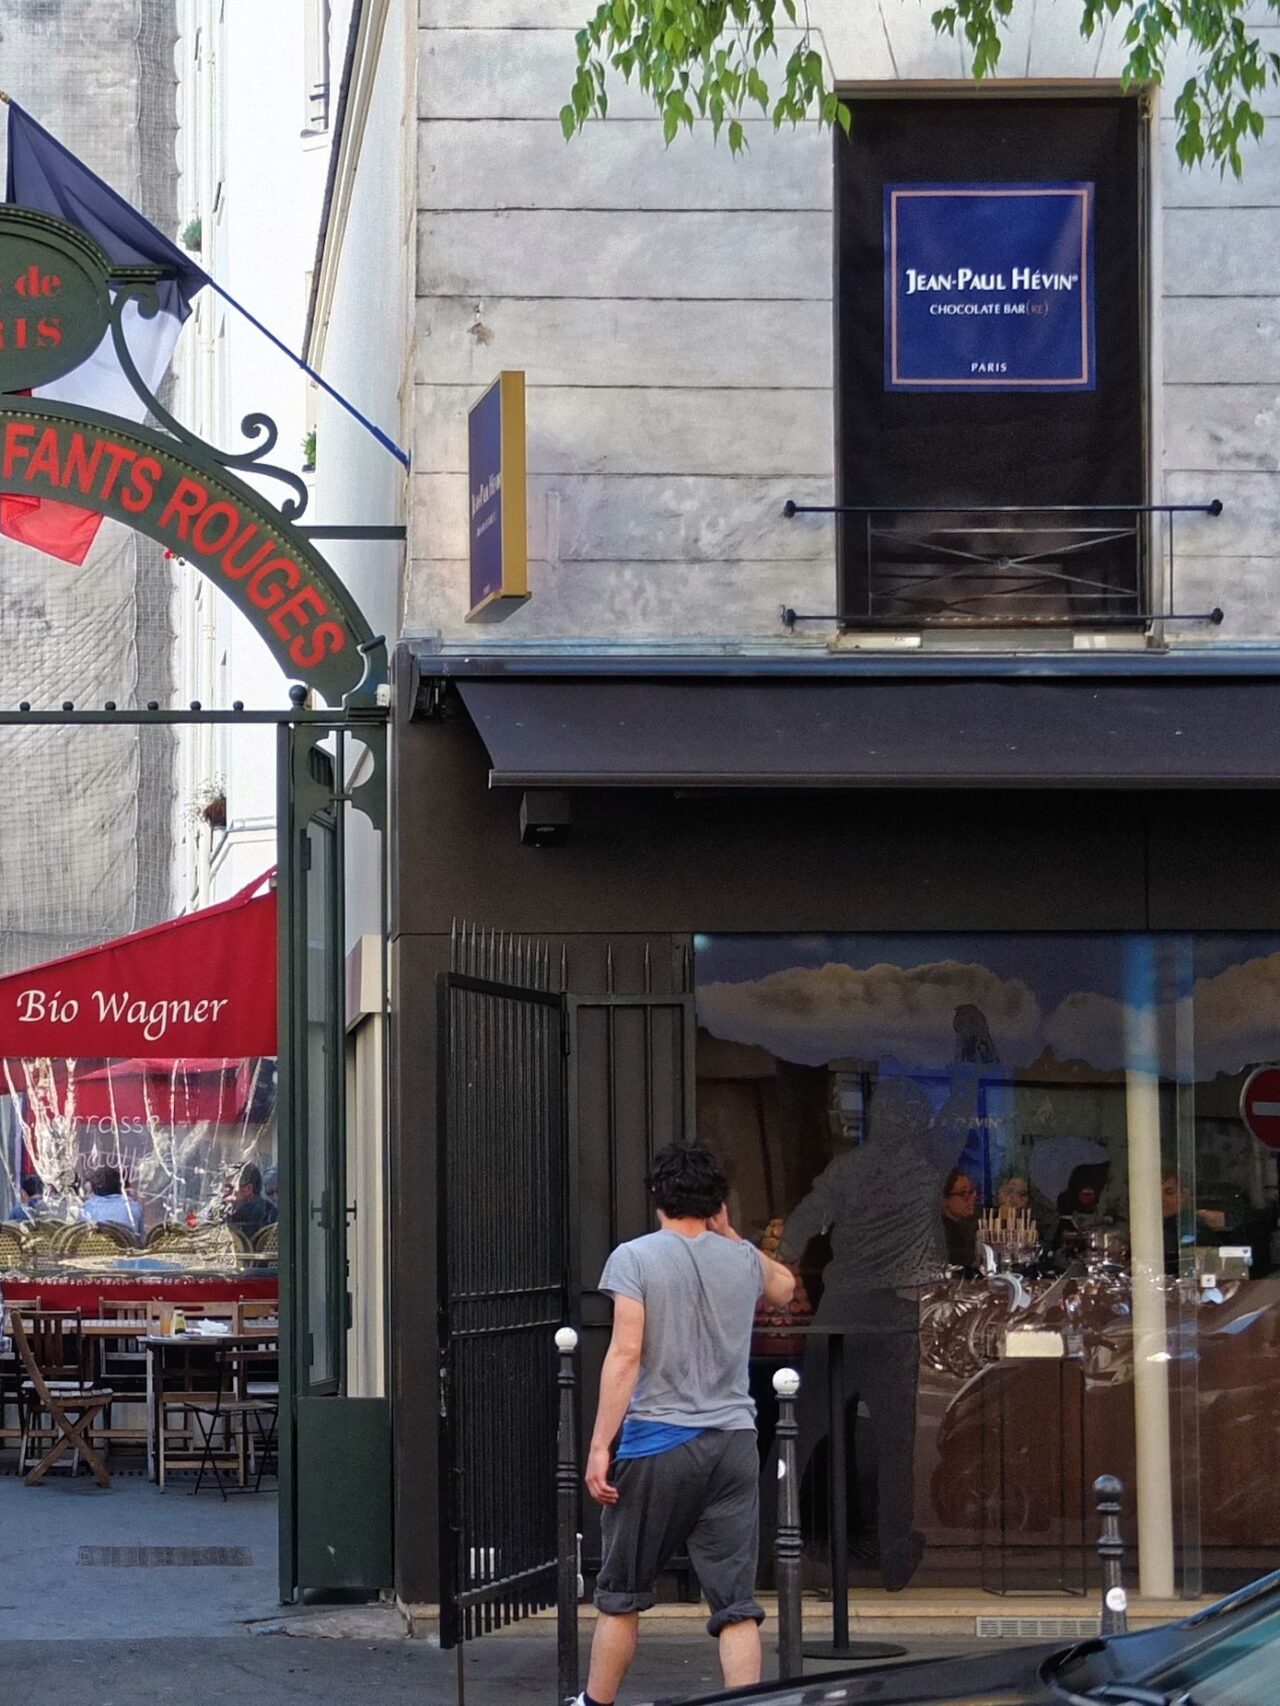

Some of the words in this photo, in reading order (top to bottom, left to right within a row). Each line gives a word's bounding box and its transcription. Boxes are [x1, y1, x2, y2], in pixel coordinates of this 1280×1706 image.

[16, 265, 62, 298] de
[929, 303, 1001, 316] CHOCOLATE
[970, 362, 1008, 374] PARIS
[159, 477, 347, 669] ROUGES
[16, 989, 79, 1023] Bio
[91, 990, 229, 1041] Wagner
